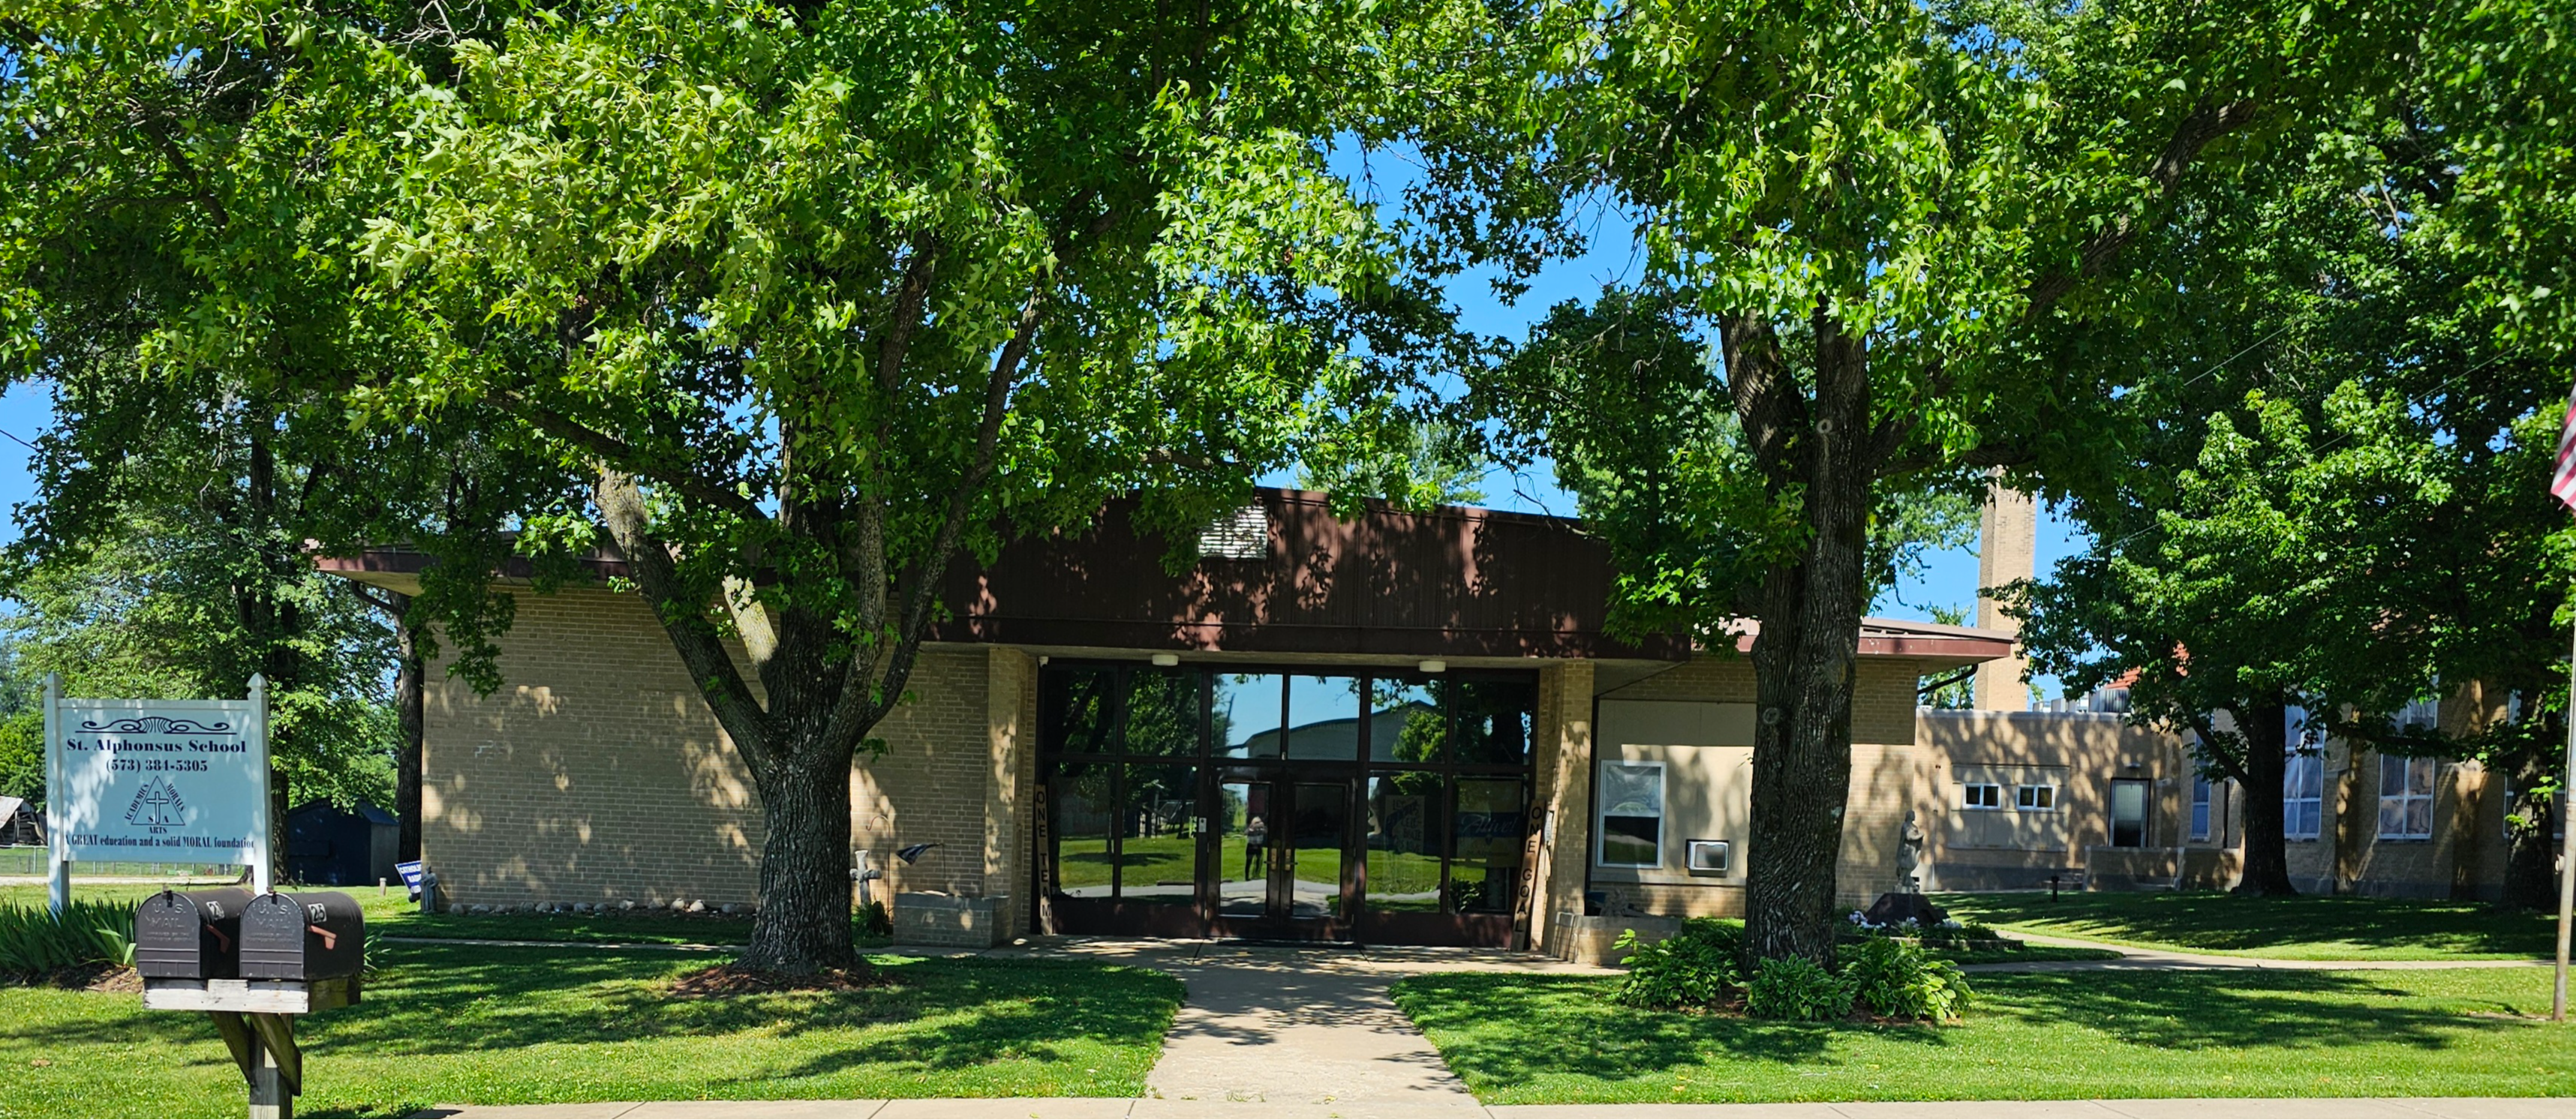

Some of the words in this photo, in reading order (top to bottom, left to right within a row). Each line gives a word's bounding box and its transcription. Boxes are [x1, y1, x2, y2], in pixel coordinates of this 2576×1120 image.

[67, 738, 88, 751] St.
[94, 739, 182, 755] Alphonsus
[188, 739, 246, 753] School
[107, 758, 140, 774] (573)
[146, 759, 208, 772] 384-5305
[125, 784, 149, 820] ACADEMICS
[167, 783, 185, 812] MORALS
[148, 815, 154, 823] S
[1036, 791, 1047, 838] ONE
[1461, 814, 1519, 833] Alive!
[72, 834, 98, 845] GREAT
[100, 835, 137, 846] education
[139, 836, 153, 846] and
[155, 838, 161, 846] a
[162, 836, 181, 847] solid
[182, 836, 212, 848] MORAL
[149, 826, 167, 834] ARTS
[1527, 806, 1542, 853] ONE
[1039, 852, 1051, 917] TEAM
[1515, 868, 1533, 932] GOAL
